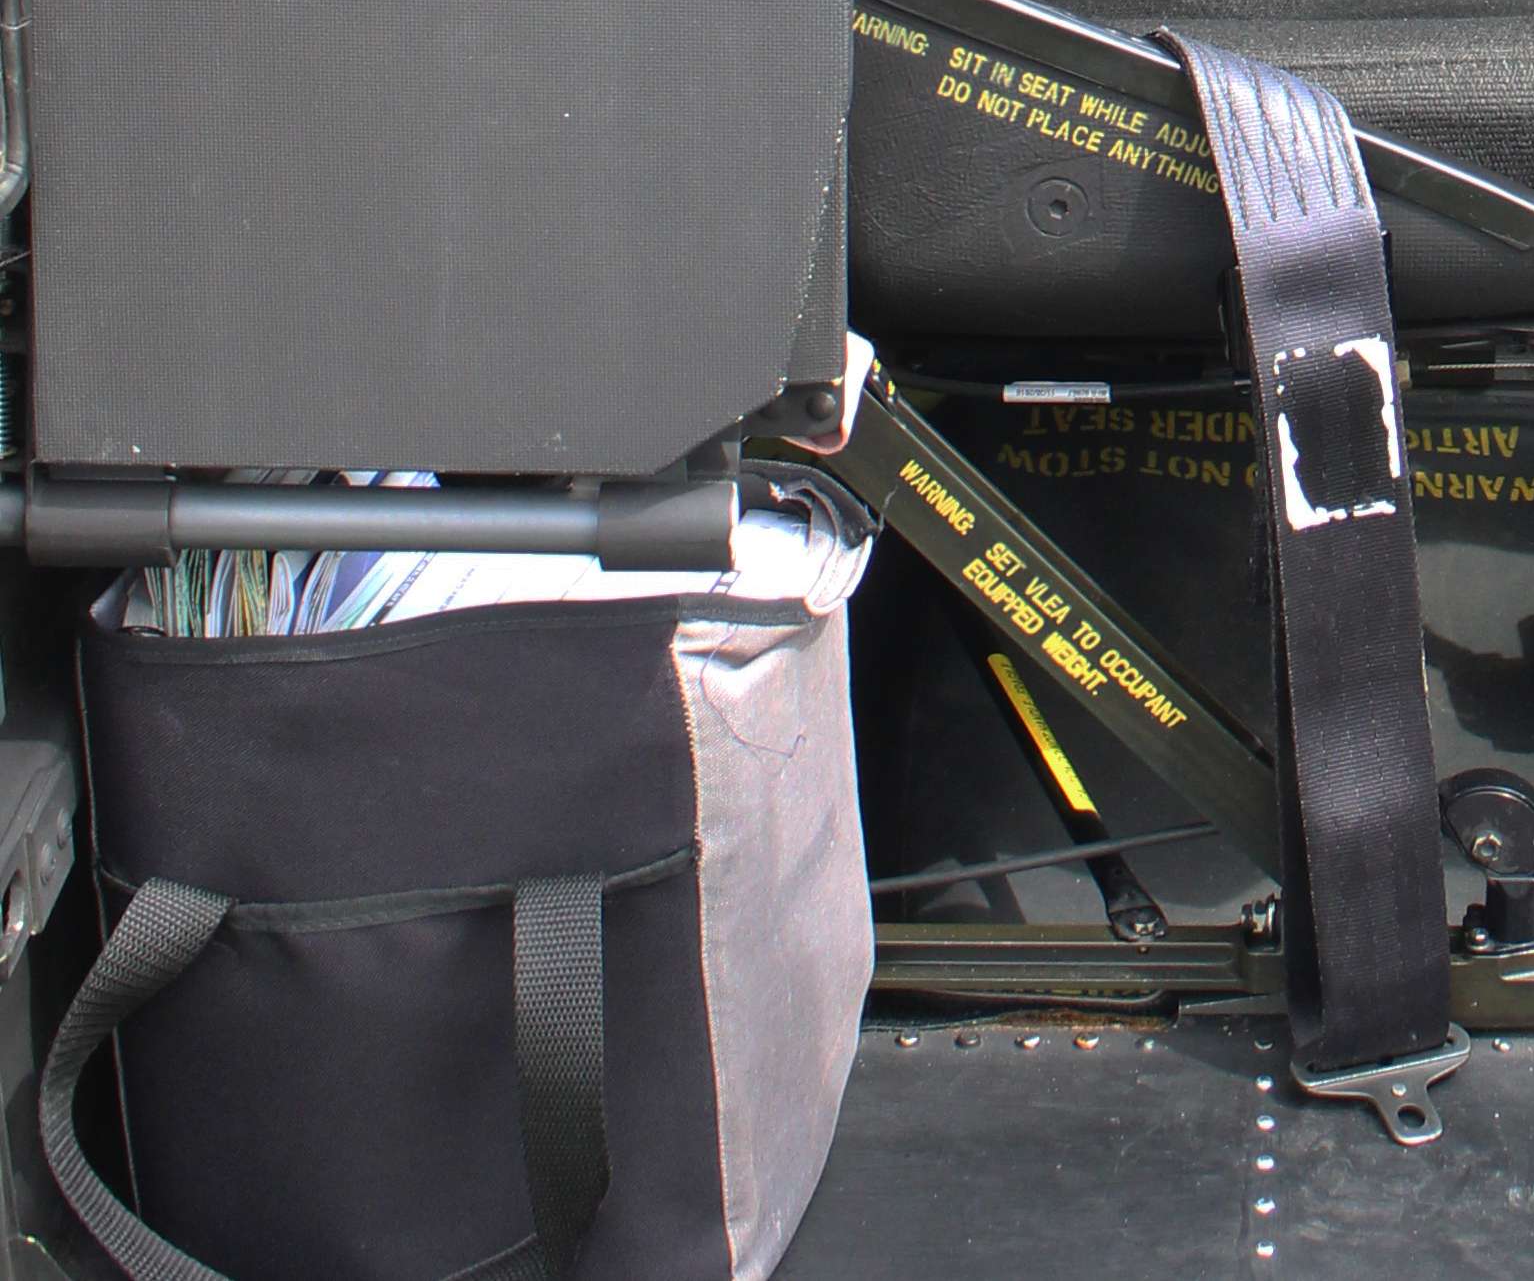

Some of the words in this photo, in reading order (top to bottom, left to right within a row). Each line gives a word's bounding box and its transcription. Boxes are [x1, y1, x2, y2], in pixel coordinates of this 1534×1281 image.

[853, 9, 930, 56] ARNING:
[949, 46, 988, 75] SIT
[990, 62, 1016, 87] IN
[1018, 71, 1076, 107] SEAT
[1079, 93, 1149, 134] WHILE
[1155, 122, 1212, 157] ADJU
[937, 74, 972, 103] DO
[977, 89, 1025, 122] NOT
[1026, 108, 1105, 152] PLACE
[1107, 139, 1219, 194] ANYTHING
[1023, 405, 1135, 435] SEAT
[1151, 410, 1259, 443] NDER
[998, 443, 1128, 477] STOW
[1406, 425, 1520, 458] ARTIC
[1139, 449, 1231, 487] NOT
[898, 459, 976, 536] WARNING:
[985, 541, 1027, 578] SET
[1024, 576, 1073, 625] VLEA
[1071, 620, 1101, 650] TO
[1100, 648, 1188, 729] OCCUPANT
[962, 557, 1045, 636] EQUIPPED
[1041, 631, 1108, 696] WEIGHT.
